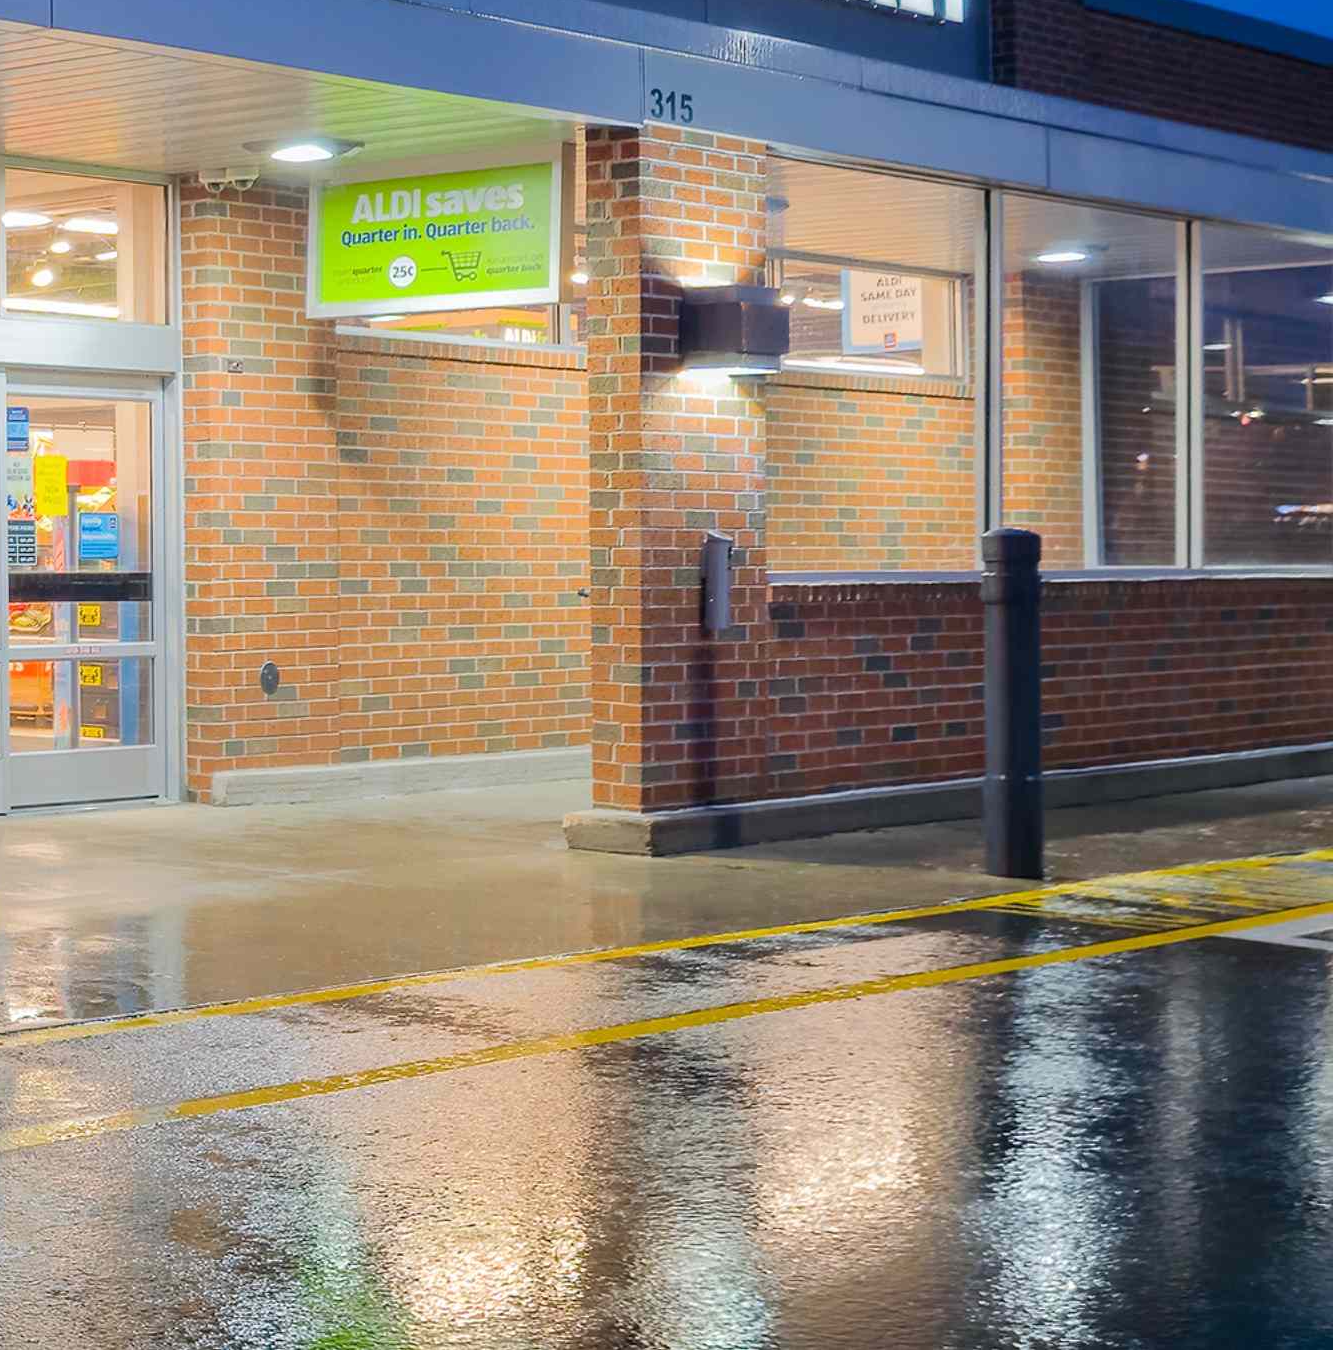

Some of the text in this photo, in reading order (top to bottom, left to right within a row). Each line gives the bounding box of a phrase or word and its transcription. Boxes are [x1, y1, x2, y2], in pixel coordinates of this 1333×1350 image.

[650, 88, 694, 124] 315
[351, 182, 525, 224] ALDI saves
[341, 215, 535, 247] Quarter in. Quarter back.
